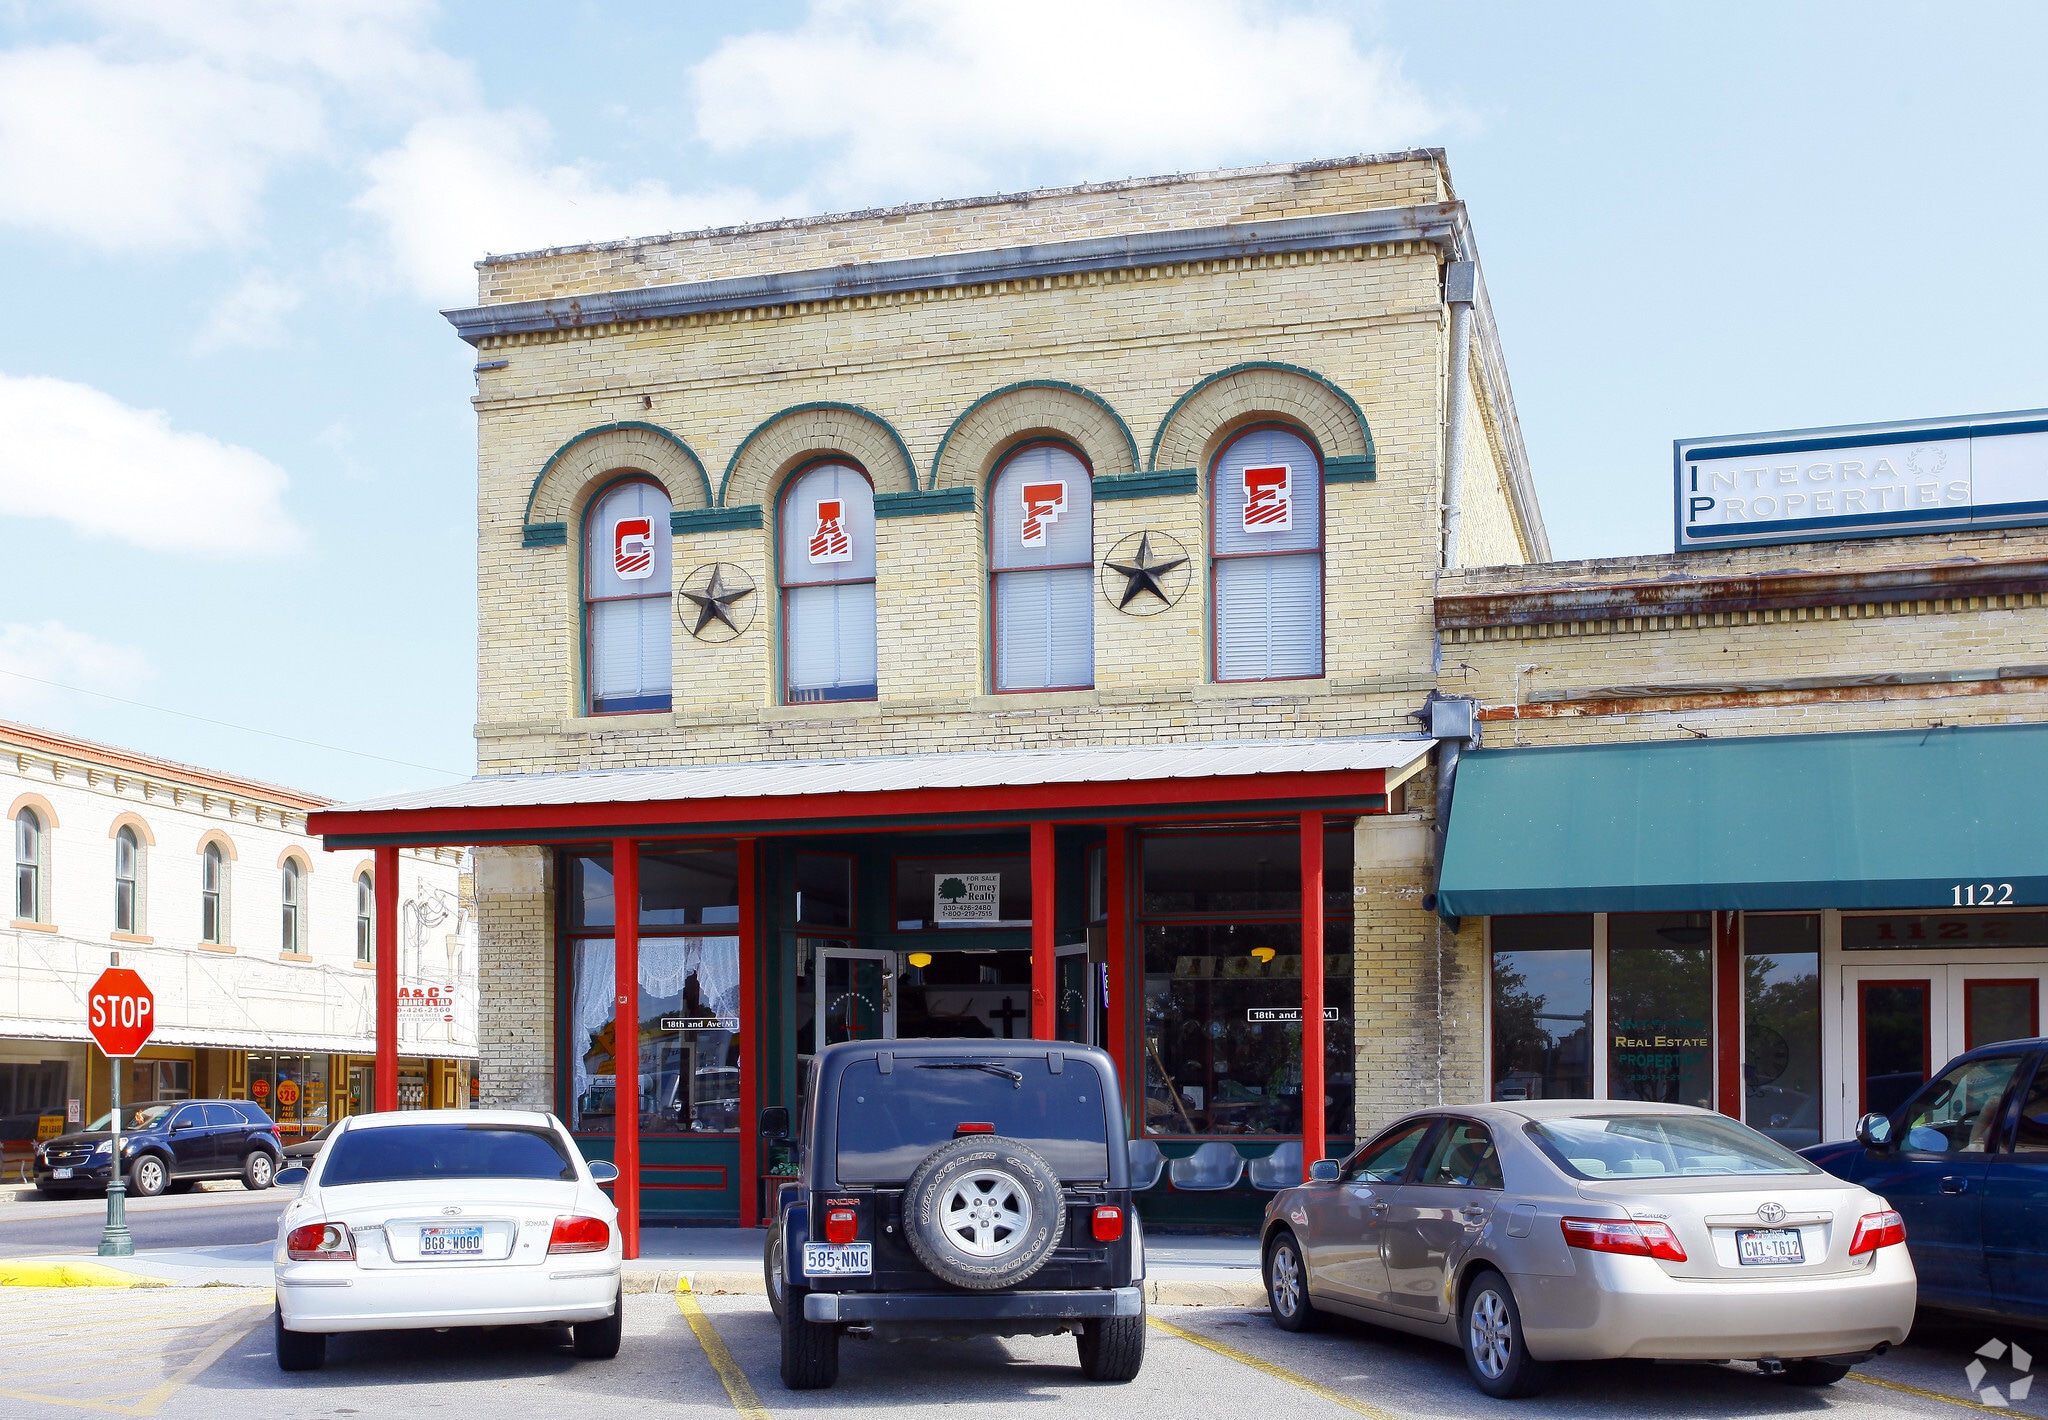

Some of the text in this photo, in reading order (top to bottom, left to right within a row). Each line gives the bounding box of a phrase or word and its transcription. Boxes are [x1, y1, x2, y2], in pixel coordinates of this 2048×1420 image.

[1689, 458, 1900, 492] INTEGRA
[1689, 480, 1970, 522] PROPERTIES
[968, 883, 997, 893] Tomey
[1951, 883, 2014, 906] 1122
[968, 892, 997, 902] Realty
[1877, 921, 2011, 940] 1122
[399, 988, 410, 997] A
[412, 989, 424, 997] &
[428, 987, 439, 997] C
[92, 994, 151, 1028] STOP
[1254, 1011, 1275, 1019] 18th
[1279, 1011, 1297, 1019] and
[687, 1020, 703, 1028] and
[1615, 1035, 1708, 1047] REAL ESTATE
[279, 1090, 296, 1101] $28
[49, 1125, 62, 1133] LEASE
[922, 1152, 996, 1225] WRANGLER
[425, 1236, 445, 1250] BG8
[1771, 1240, 1799, 1256] T612
[808, 1251, 868, 1267] 585 NNG
